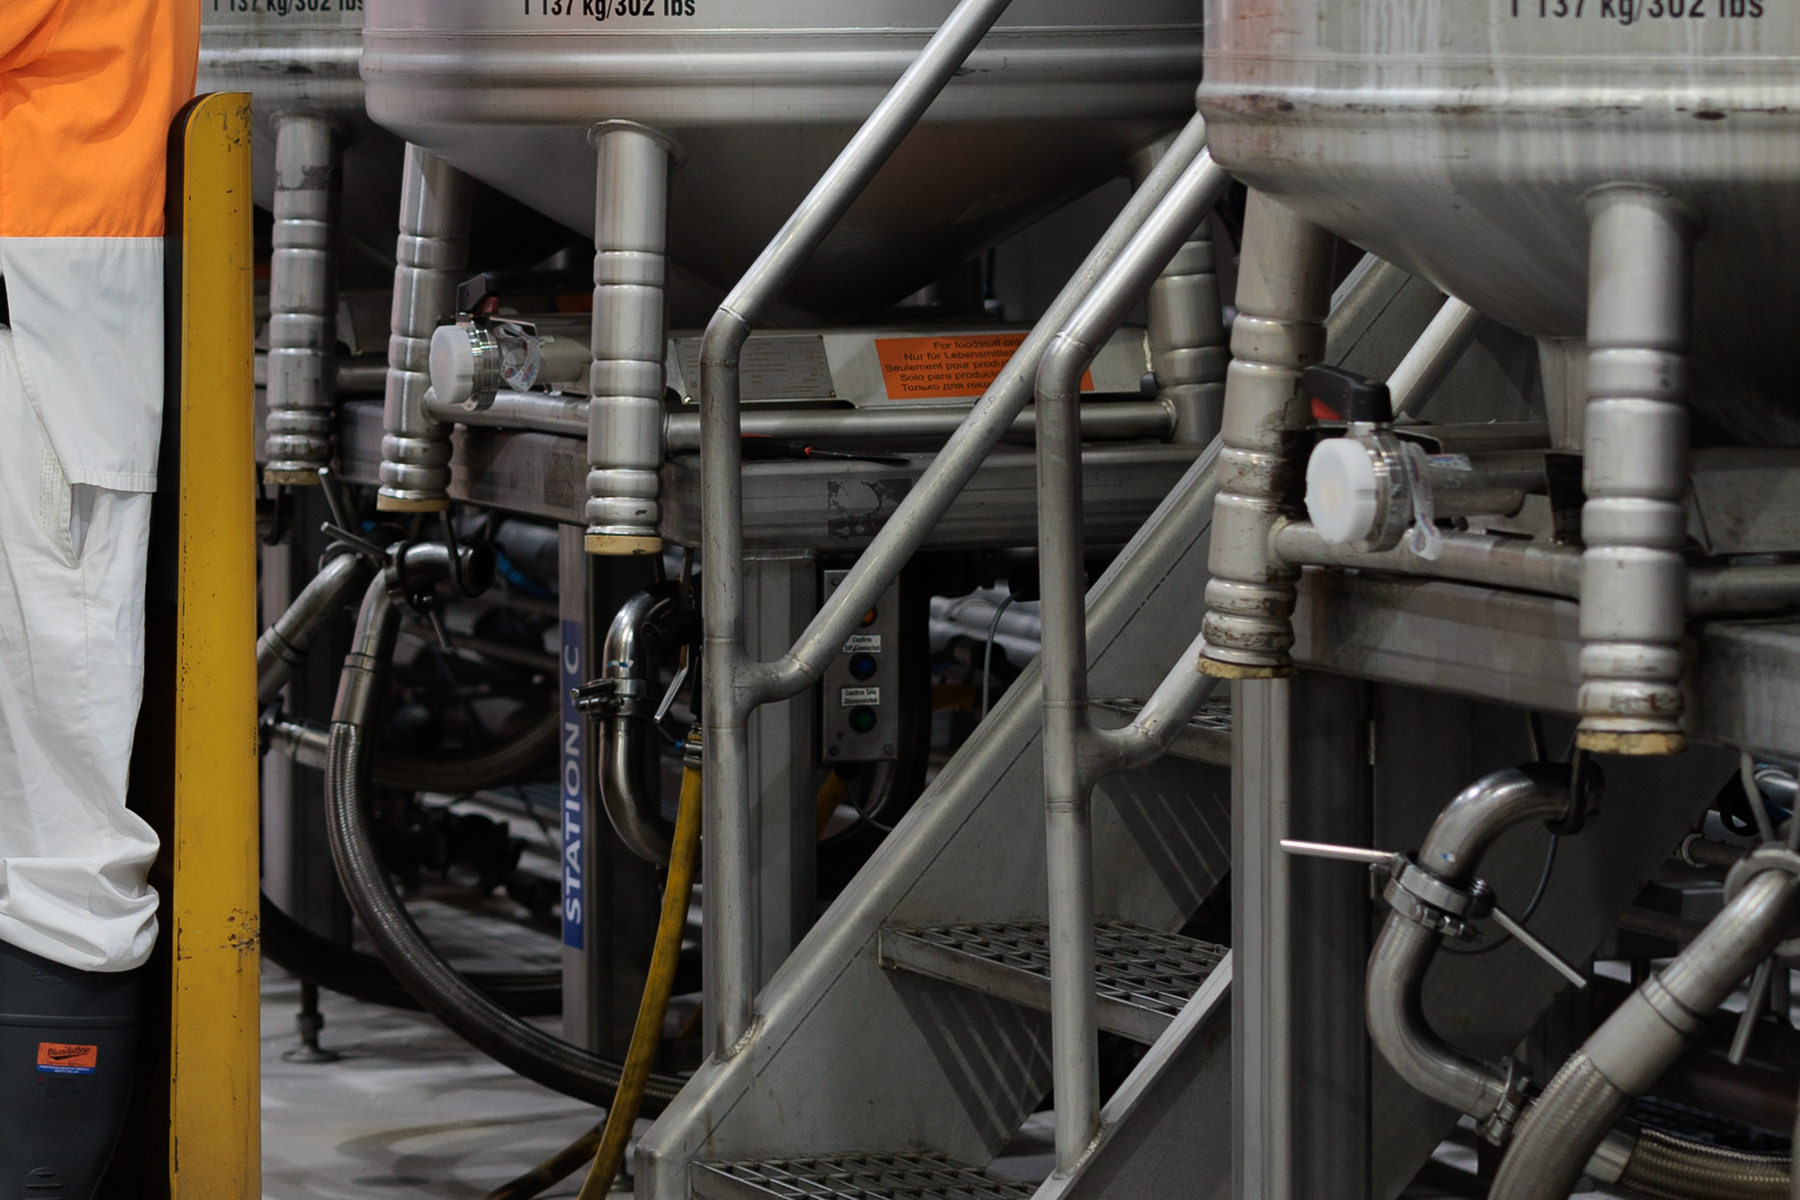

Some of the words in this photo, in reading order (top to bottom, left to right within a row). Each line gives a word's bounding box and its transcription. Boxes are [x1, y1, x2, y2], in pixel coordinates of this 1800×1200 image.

[933, 341, 952, 350] For
[955, 340, 1001, 349] foodstuff
[904, 352, 924, 361] Nur
[927, 351, 941, 359] für
[885, 362, 943, 372] Seulement
[946, 362, 970, 372] pour
[900, 373, 925, 382] Solo
[928, 373, 952, 382] para
[901, 383, 940, 392] Только
[943, 383, 964, 391] для
[564, 645, 580, 675] C
[564, 722, 582, 925] STATION
